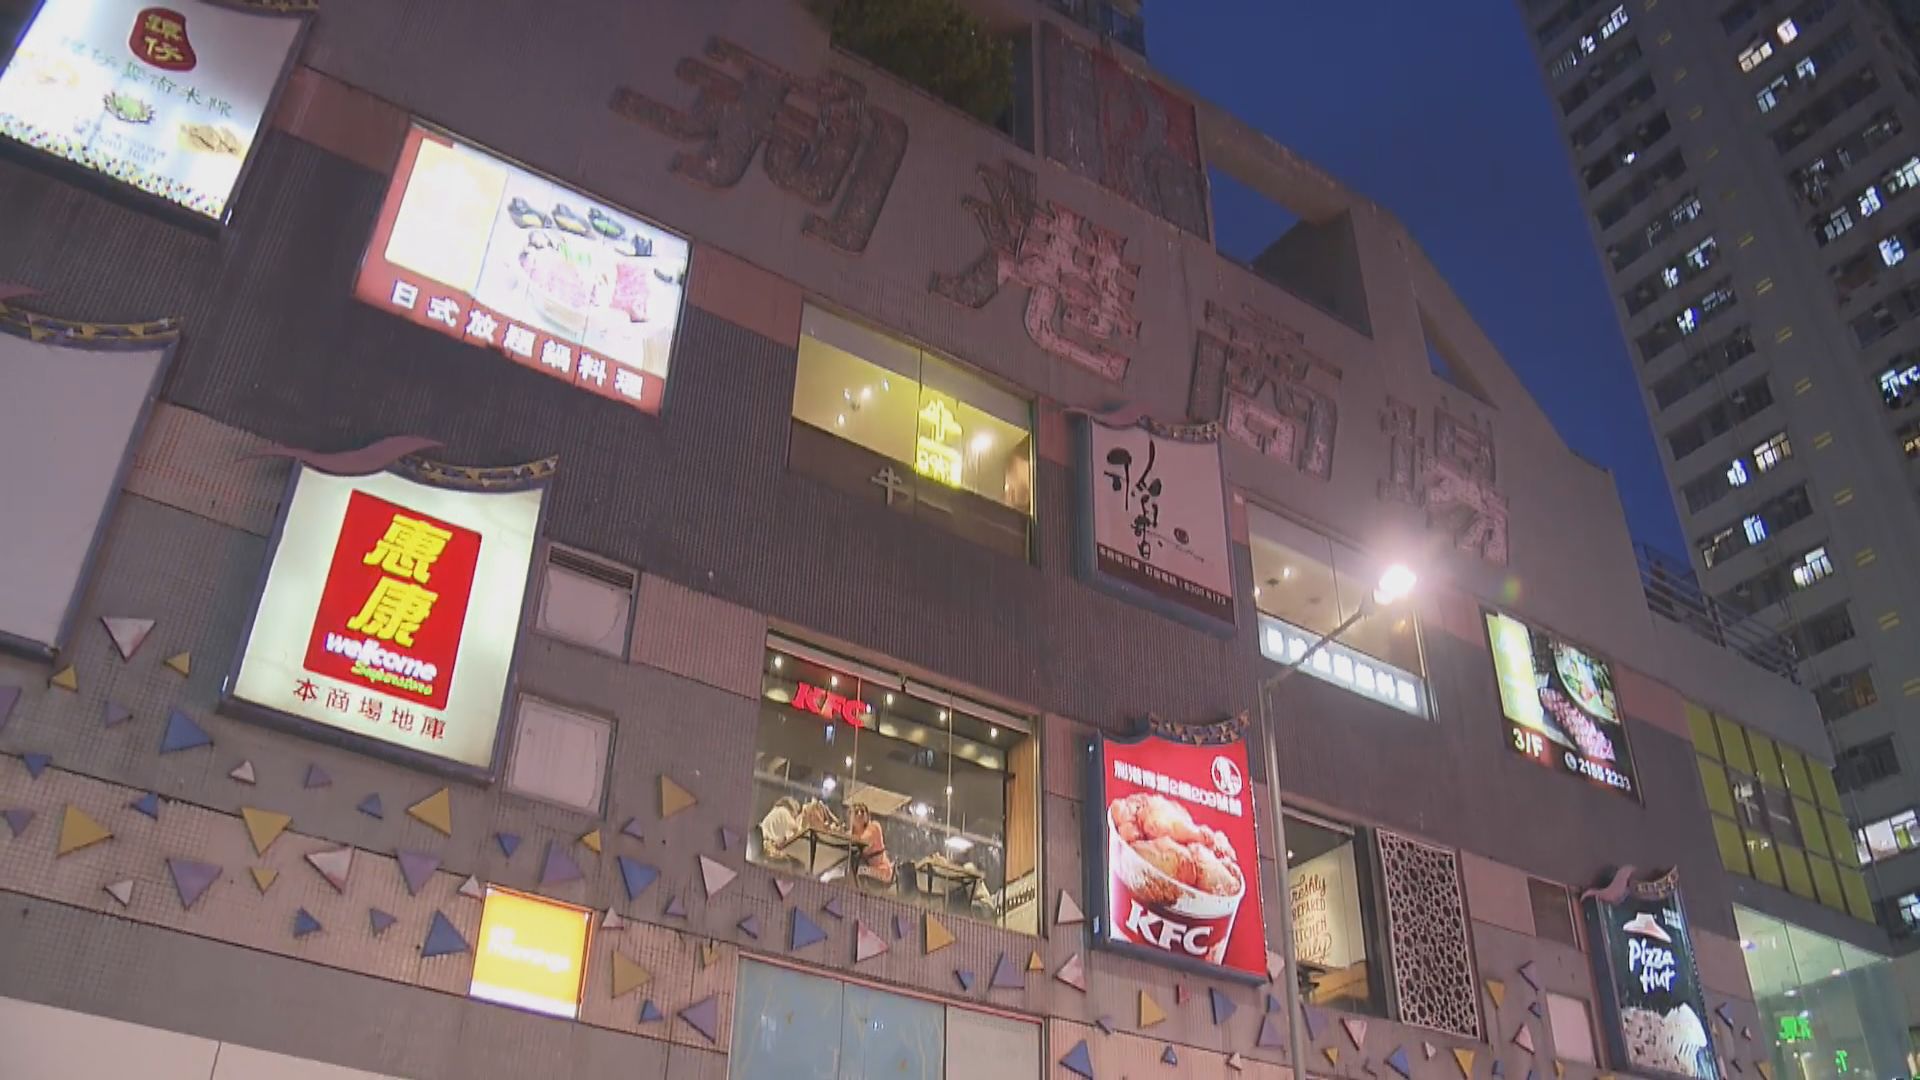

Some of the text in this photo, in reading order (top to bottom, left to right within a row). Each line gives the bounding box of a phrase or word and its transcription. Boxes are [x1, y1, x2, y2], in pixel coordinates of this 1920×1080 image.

[346, 513, 453, 648] 惠康
[293, 678, 446, 740] 本商場地庫
[791, 681, 867, 729] KFC
[1512, 727, 1543, 757] 3/F
[1125, 897, 1214, 956] KFC
[1628, 937, 1675, 972] Pizza
[1640, 964, 1676, 994] Hut
